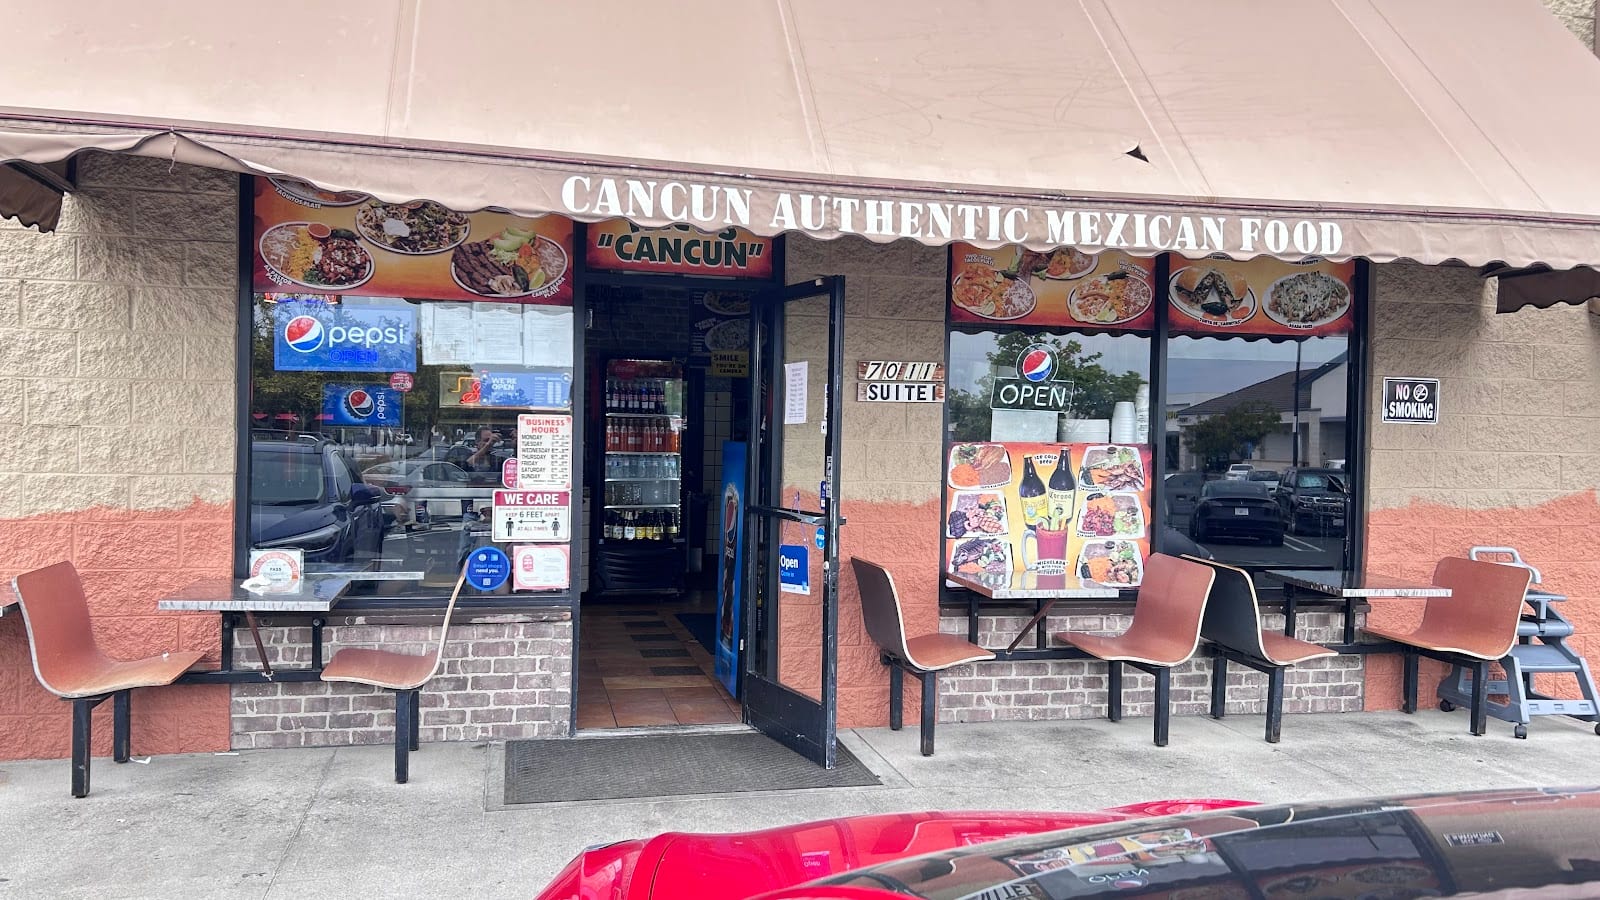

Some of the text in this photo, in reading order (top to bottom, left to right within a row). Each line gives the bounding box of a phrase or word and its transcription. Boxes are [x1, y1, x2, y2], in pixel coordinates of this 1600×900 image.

[561, 175, 752, 226] CANCUN
[770, 193, 1028, 243] AUTHENTIC
[1045, 209, 1226, 250] MEXICAN
[1240, 217, 1343, 255] FOOD
[328, 324, 404, 348] pepsi
[329, 350, 379, 363] OPEN
[713, 354, 739, 362] SMILE
[491, 383, 514, 391] OPEN
[1395, 384, 1410, 400] NO
[999, 384, 1066, 407] OPEN
[375, 392, 386, 420] pepsi
[1389, 401, 1434, 418] SMOKING
[531, 426, 559, 434] HOURS
[504, 493, 560, 505] WE CARE
[780, 555, 799, 570] Open
